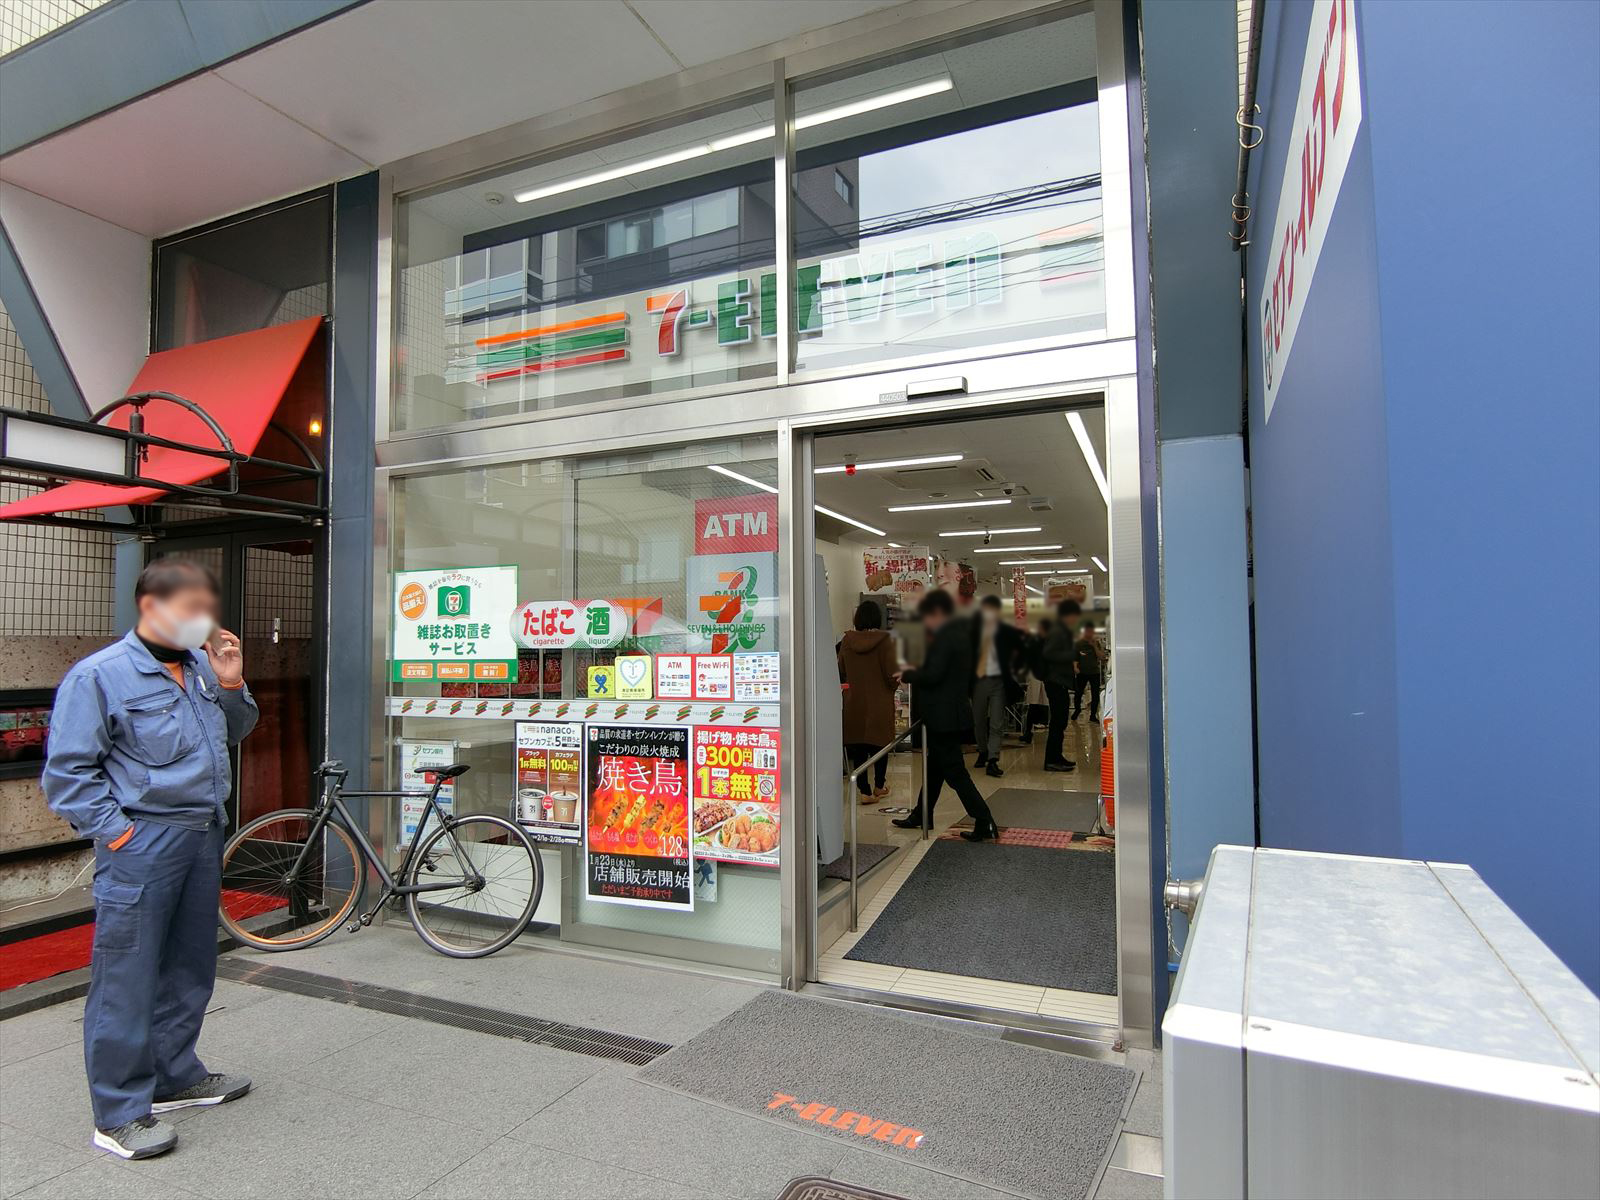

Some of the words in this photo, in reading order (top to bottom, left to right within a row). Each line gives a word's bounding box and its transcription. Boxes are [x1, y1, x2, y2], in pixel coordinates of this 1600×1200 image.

[703, 511, 768, 539] ATM
[523, 607, 575, 636] たばこ
[586, 607, 610, 635] 酒
[417, 623, 491, 640] 雑誌お取置き
[429, 641, 477, 656] サービス
[533, 637, 565, 646] cigarette
[588, 638, 610, 646] liquor
[667, 661, 682, 669] ATM
[712, 661, 730, 669] Wi-Fi
[697, 730, 778, 748] 揚げ物・焼き鳥を
[598, 743, 680, 758] こだわりの炭火焼成
[705, 745, 753, 768] 300円
[597, 756, 683, 797] 焼き鳥
[594, 865, 691, 889] 店舗販売開始
